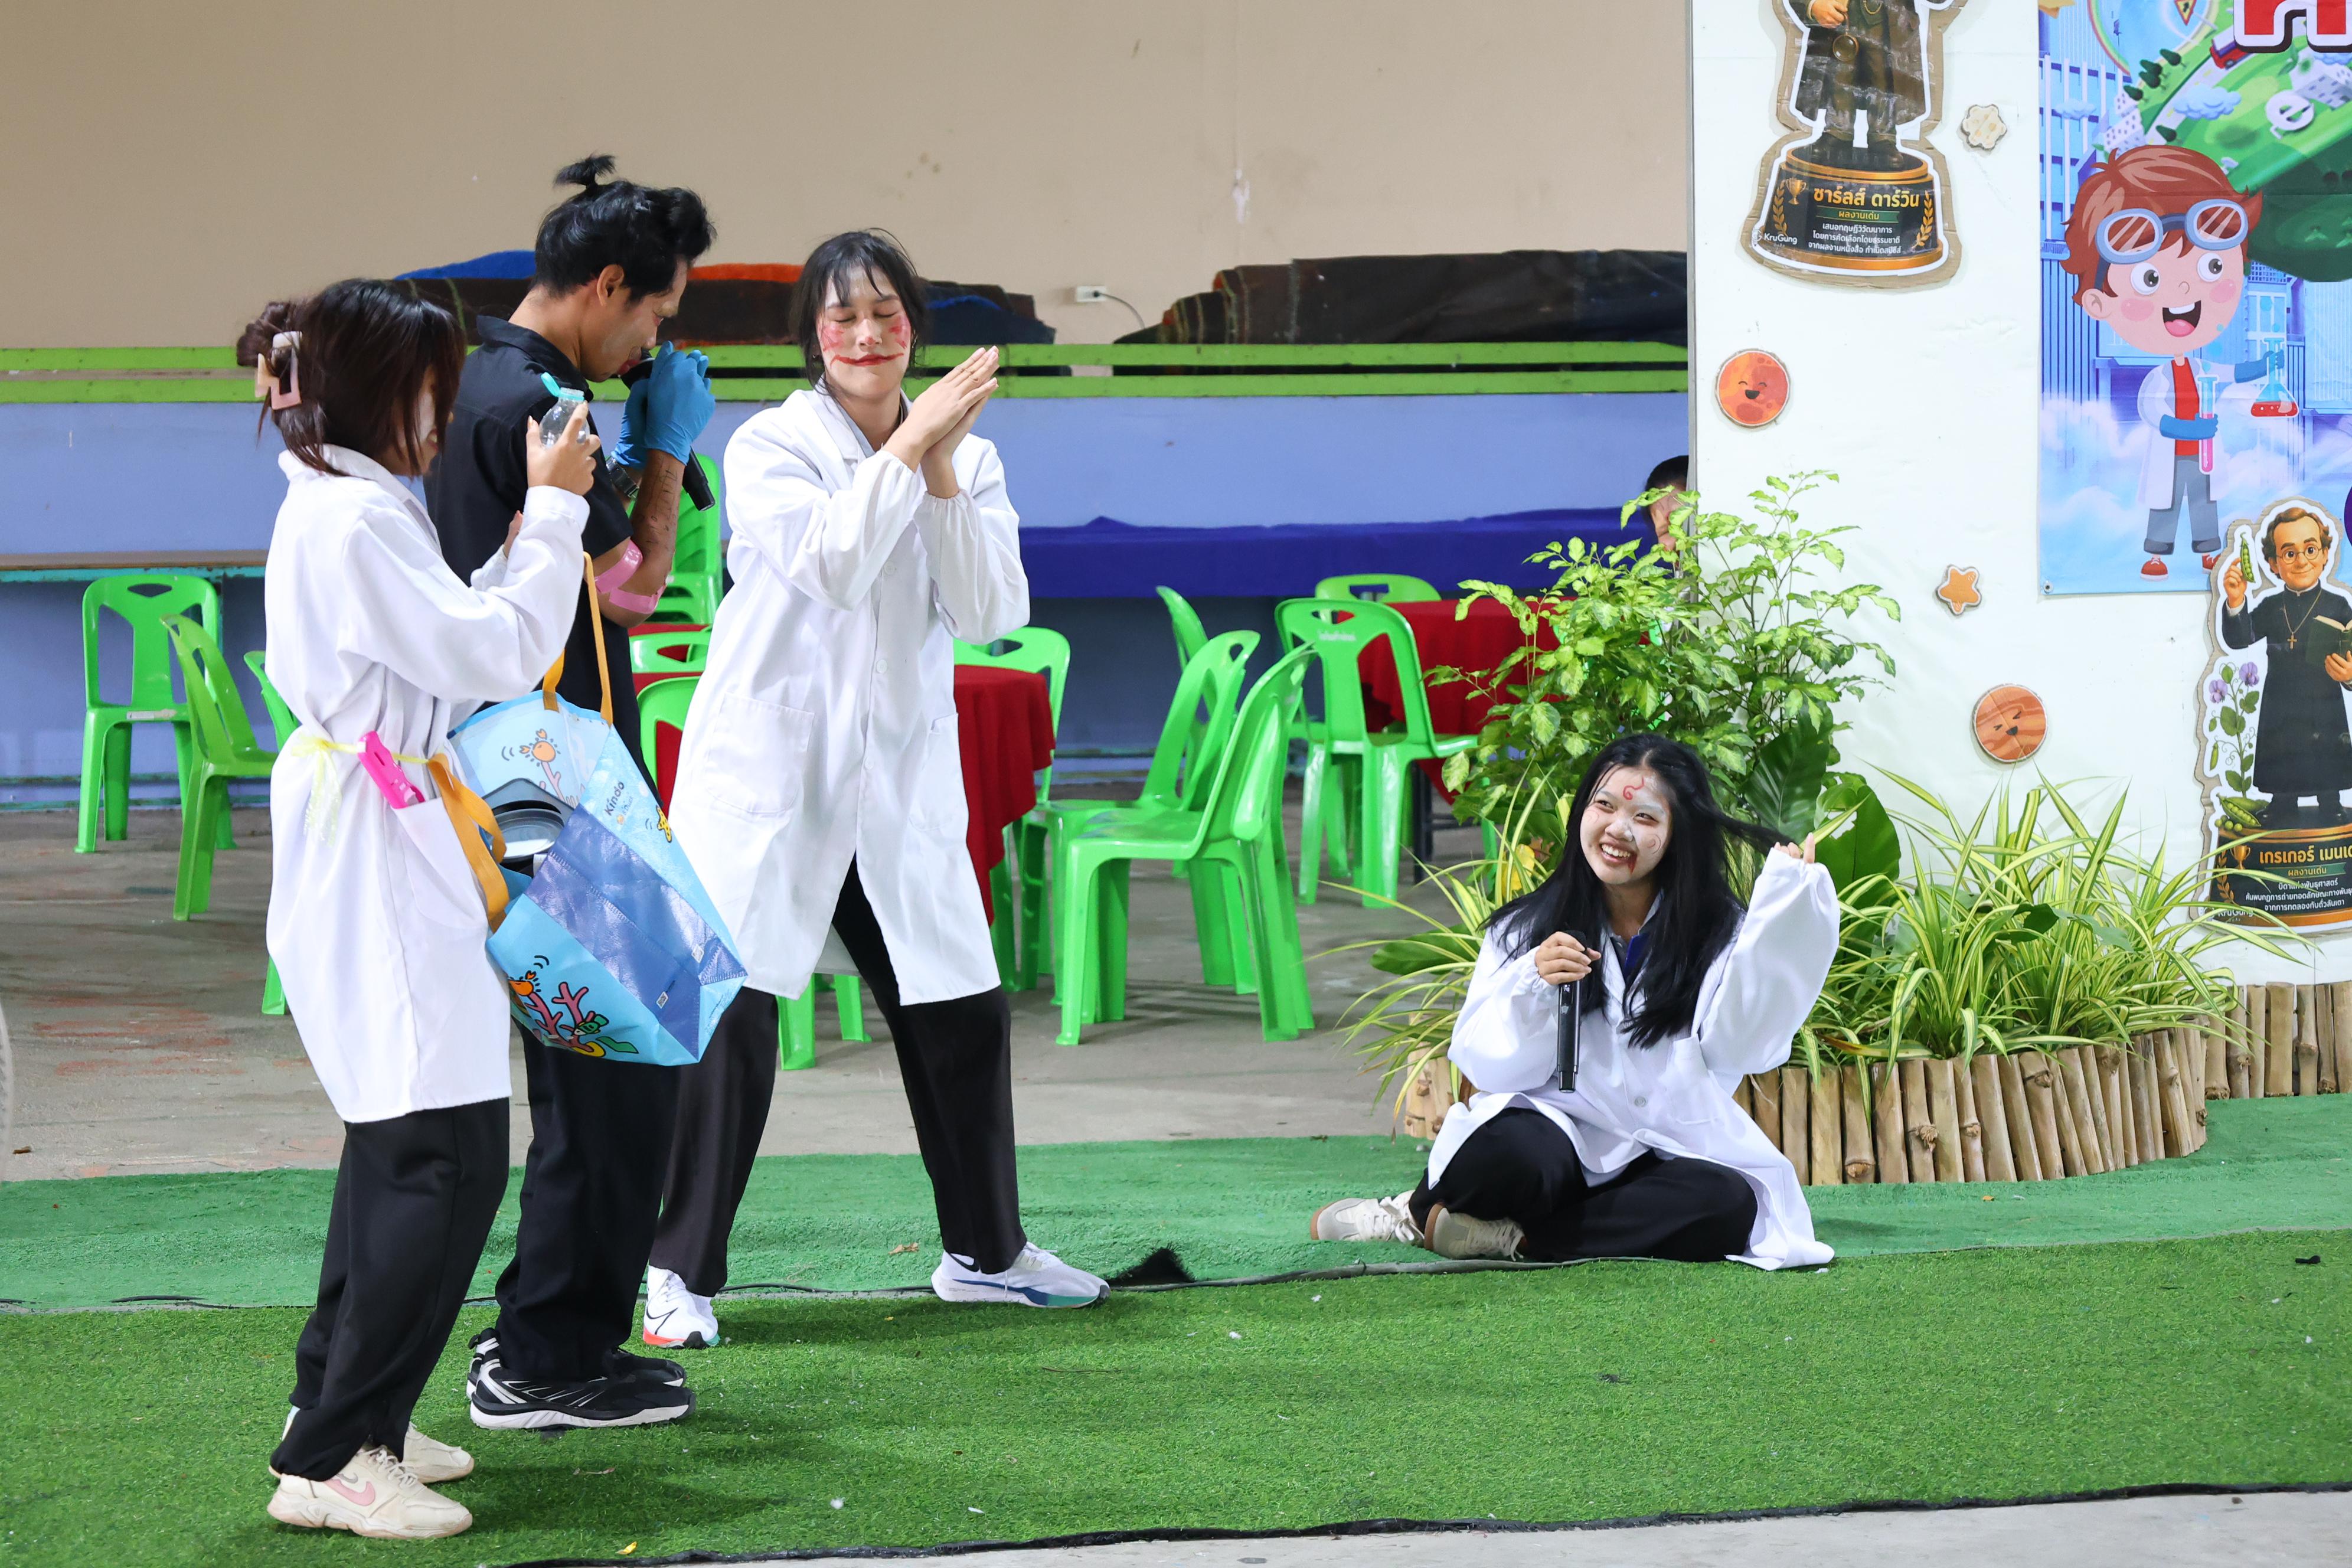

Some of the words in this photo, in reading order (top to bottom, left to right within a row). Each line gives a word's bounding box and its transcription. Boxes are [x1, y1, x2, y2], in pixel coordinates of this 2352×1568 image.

[1814, 186, 1866, 206] ชาร์ลส์
[1871, 189, 1920, 207] ดาร์วิน
[1838, 210, 1880, 220] ผลงานเด่น
[1764, 233, 1798, 245] KruGung
[604, 781, 625, 816] Kindo
[2259, 845, 2315, 864] เกรเกอร์
[2288, 866, 2327, 876] ผลงานเด่น
[2246, 887, 2352, 903] ค้นพบกฎการถ่ายทอดลักษณะทางพันธุ
[2265, 899, 2345, 912] จากการทดลองกับถั่วลันเตา
